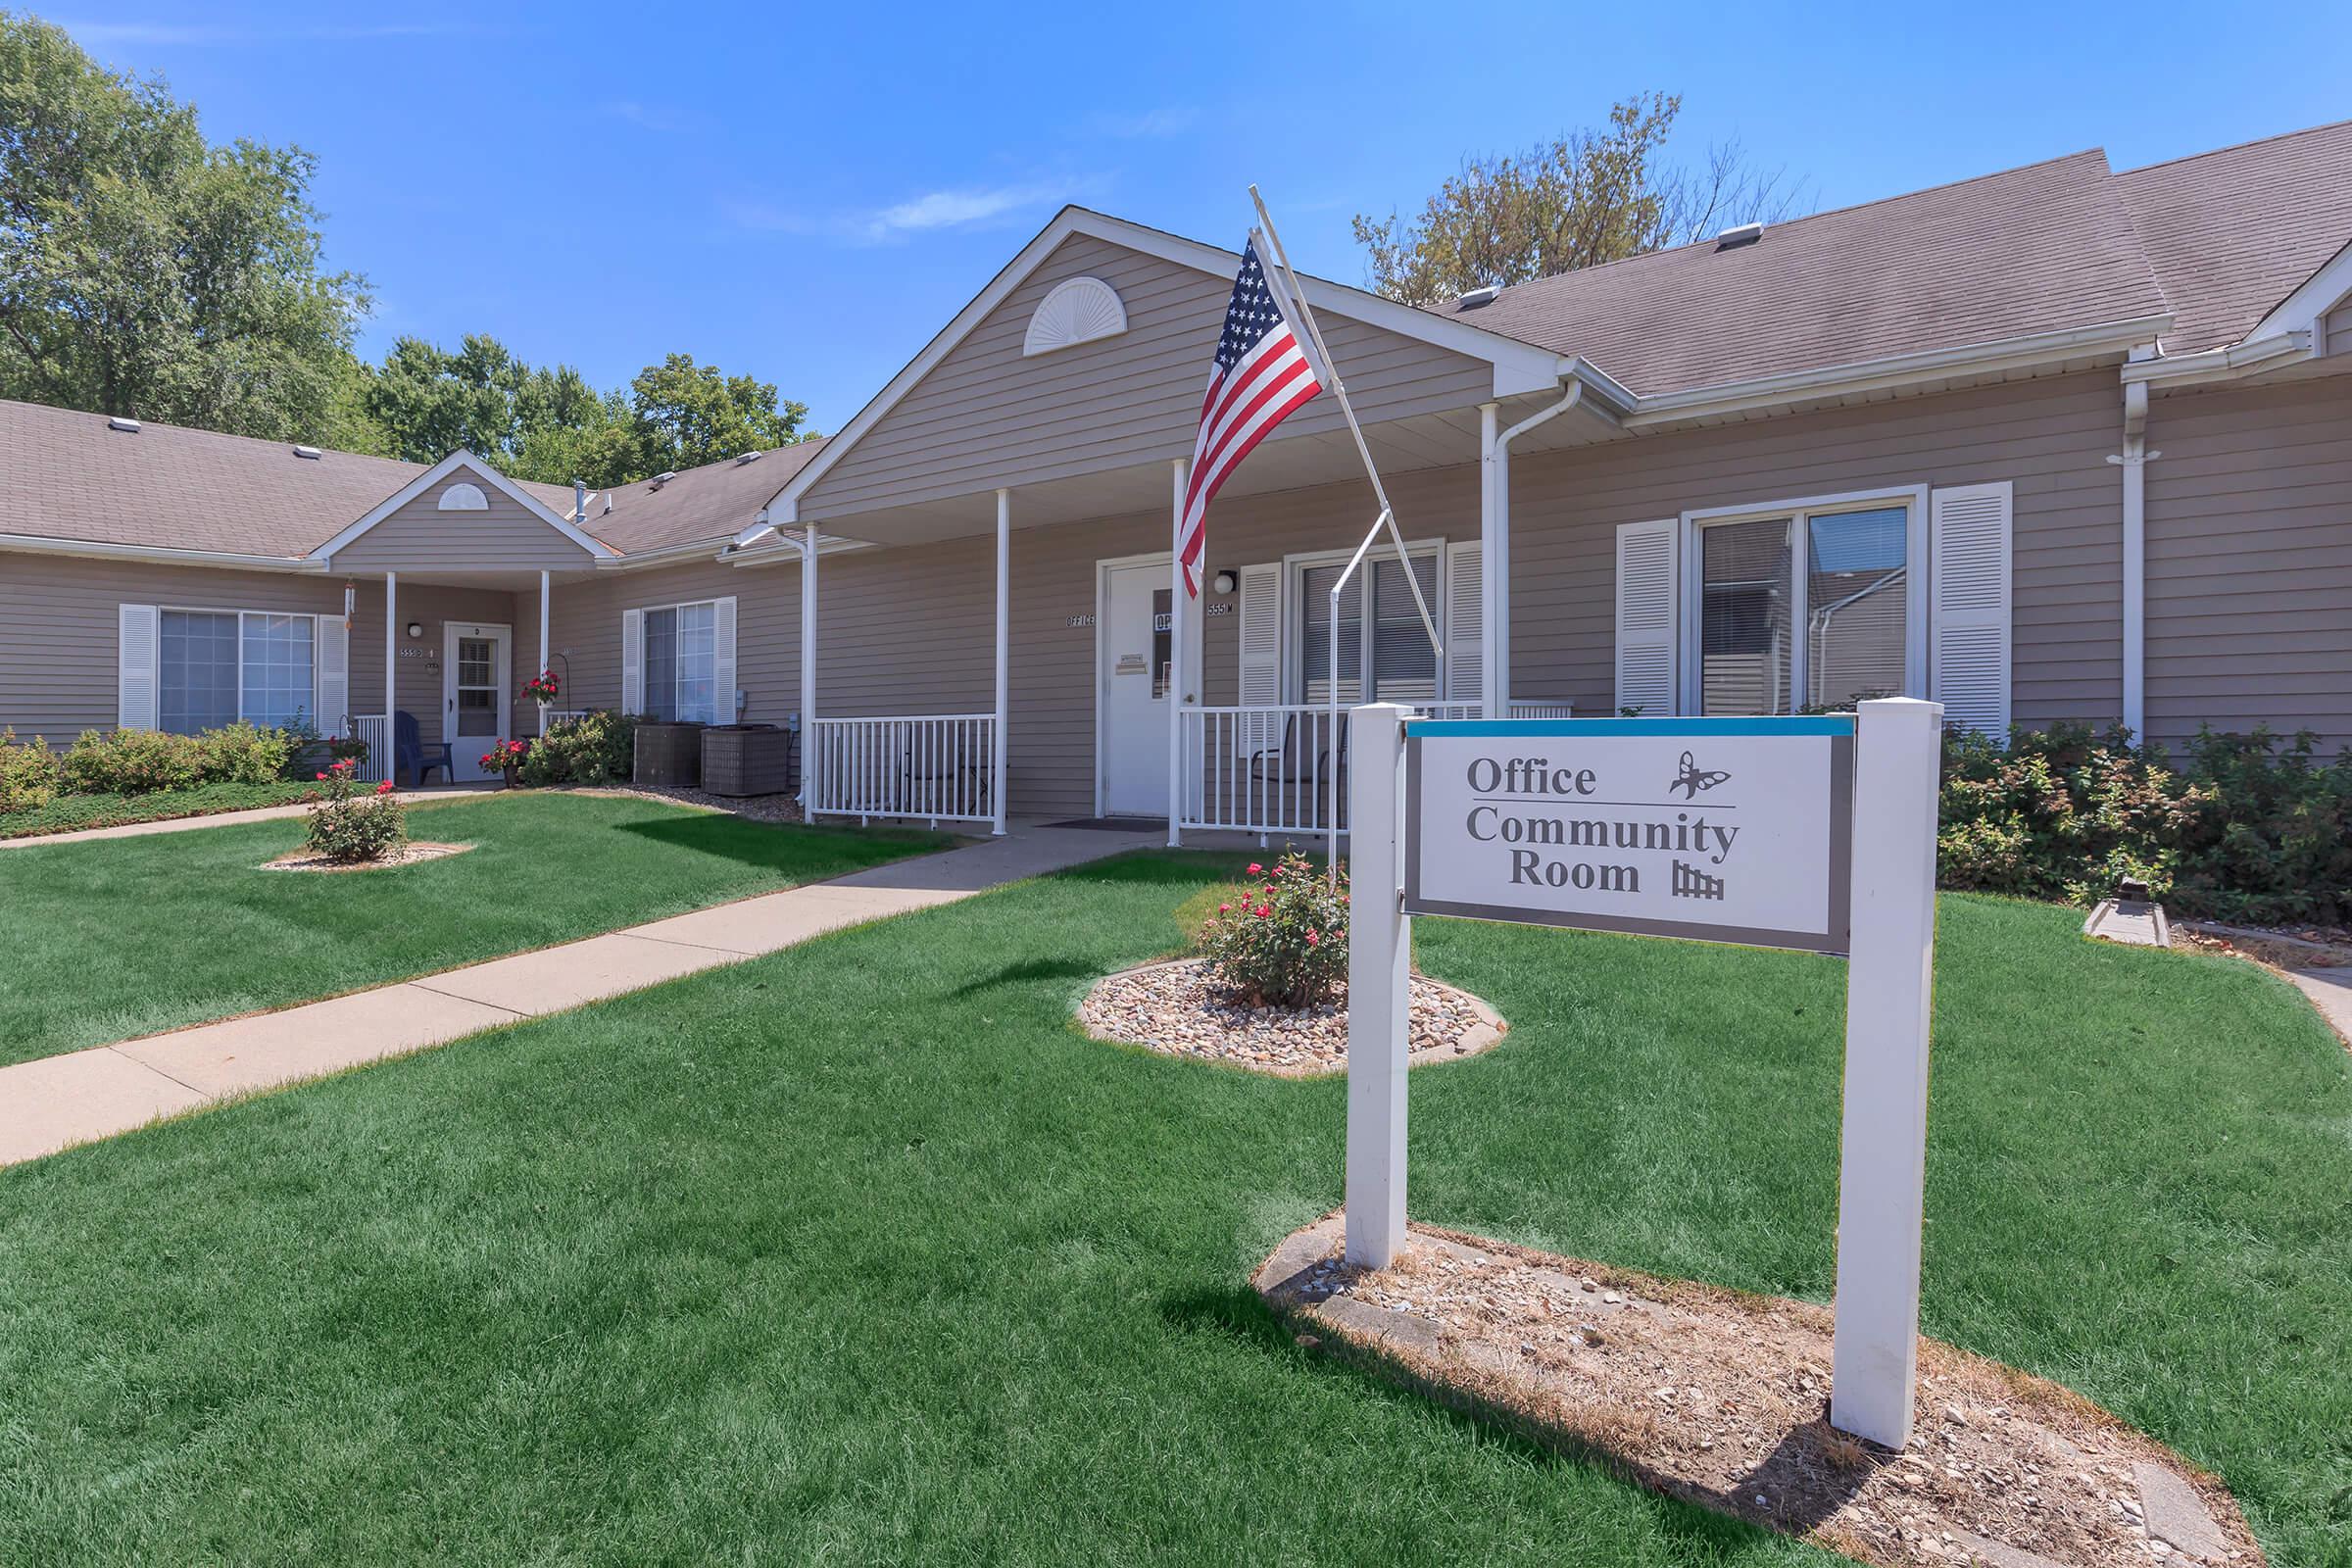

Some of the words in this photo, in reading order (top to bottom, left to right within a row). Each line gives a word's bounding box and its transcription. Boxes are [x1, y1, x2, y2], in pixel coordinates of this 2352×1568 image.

[1066, 614, 1095, 627] OFFICE
[1156, 614, 1171, 629] OP
[1207, 604, 1225, 614] 555
[1467, 758, 1596, 795] Office
[1466, 806, 1740, 864] Community
[1508, 849, 1641, 893] Room
